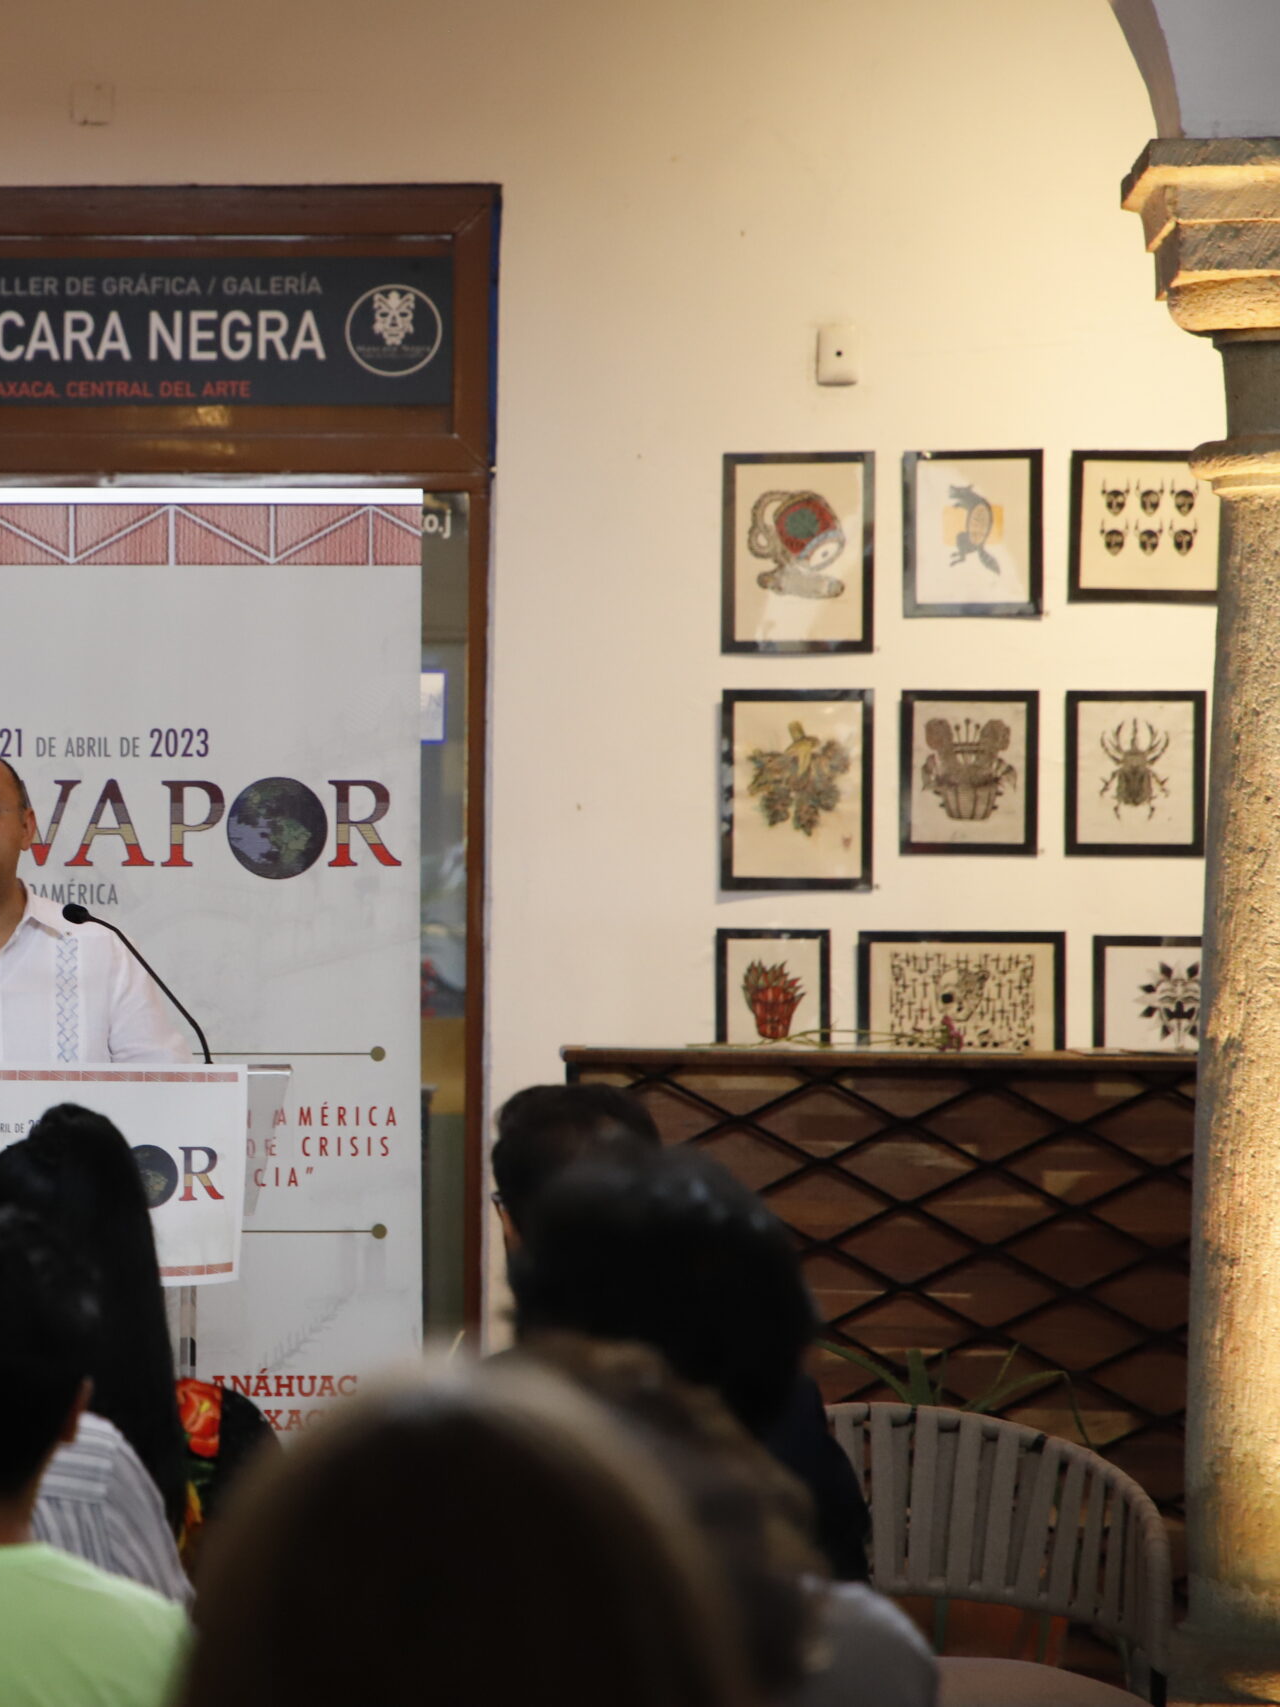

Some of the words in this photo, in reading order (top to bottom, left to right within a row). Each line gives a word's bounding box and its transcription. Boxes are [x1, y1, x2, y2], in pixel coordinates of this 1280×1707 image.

[66, 276, 96, 296] DE
[102, 271, 202, 296] GRÁFICA
[222, 271, 323, 296] GALERÍA
[148, 310, 327, 362] NEGRA
[66, 380, 153, 398] CENTRAL
[162, 380, 197, 398] DEL
[202, 380, 252, 398] ARTE
[0, 728, 23, 757] 21
[36, 737, 56, 757] DE
[65, 737, 111, 757] ABRIL
[120, 737, 140, 757] DE
[149, 728, 209, 757] 2023
[15, 1123, 24, 1133] DE
[302, 1136, 390, 1157] CRISIS
